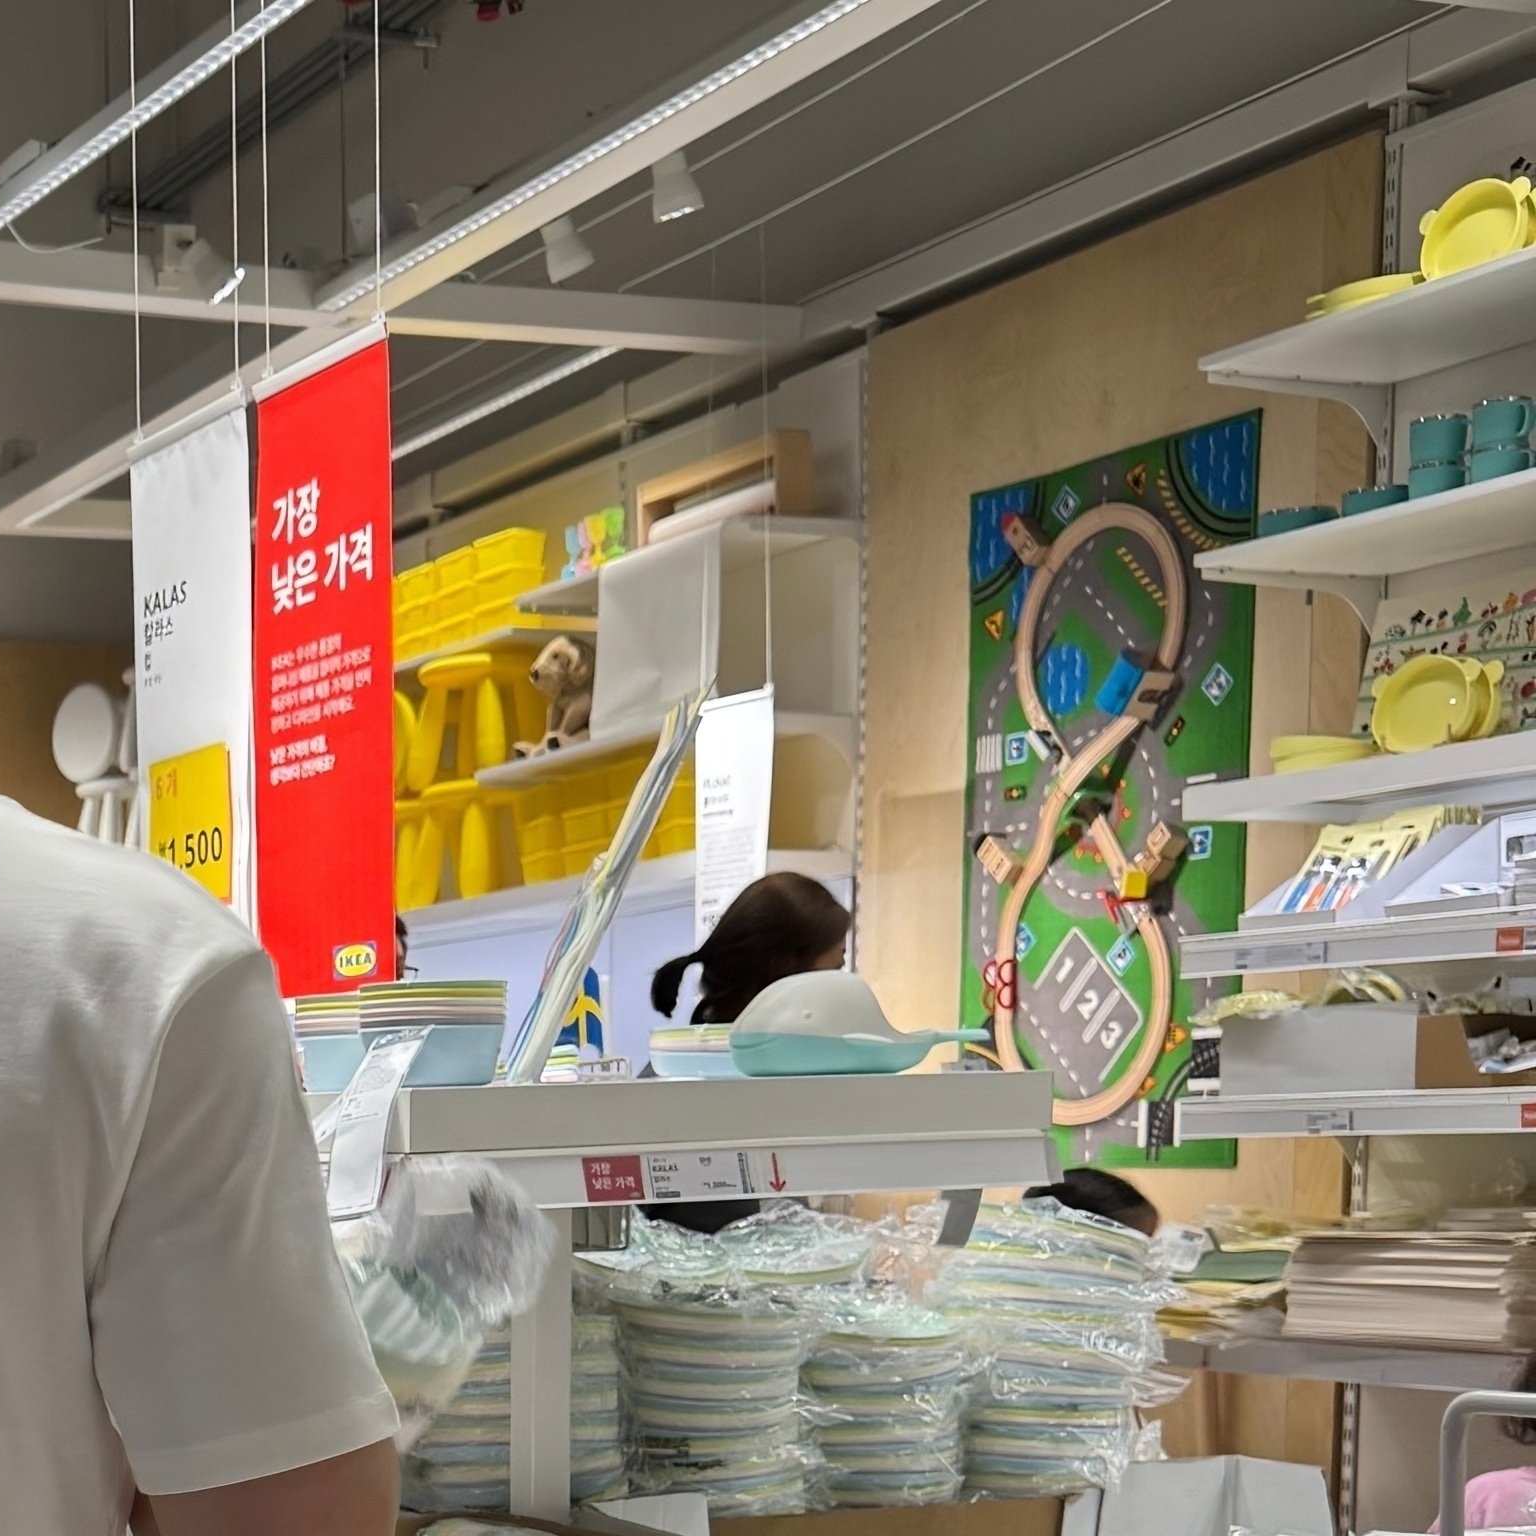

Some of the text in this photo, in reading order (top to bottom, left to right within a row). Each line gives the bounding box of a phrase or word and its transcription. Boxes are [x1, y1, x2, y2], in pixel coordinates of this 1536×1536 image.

[272, 476, 320, 544] 가장
[144, 580, 187, 619] KALAS
[272, 521, 373, 616] 낮은 가격
[340, 952, 372, 968] IKEA
[1055, 956, 1122, 1050] 1 2 3
